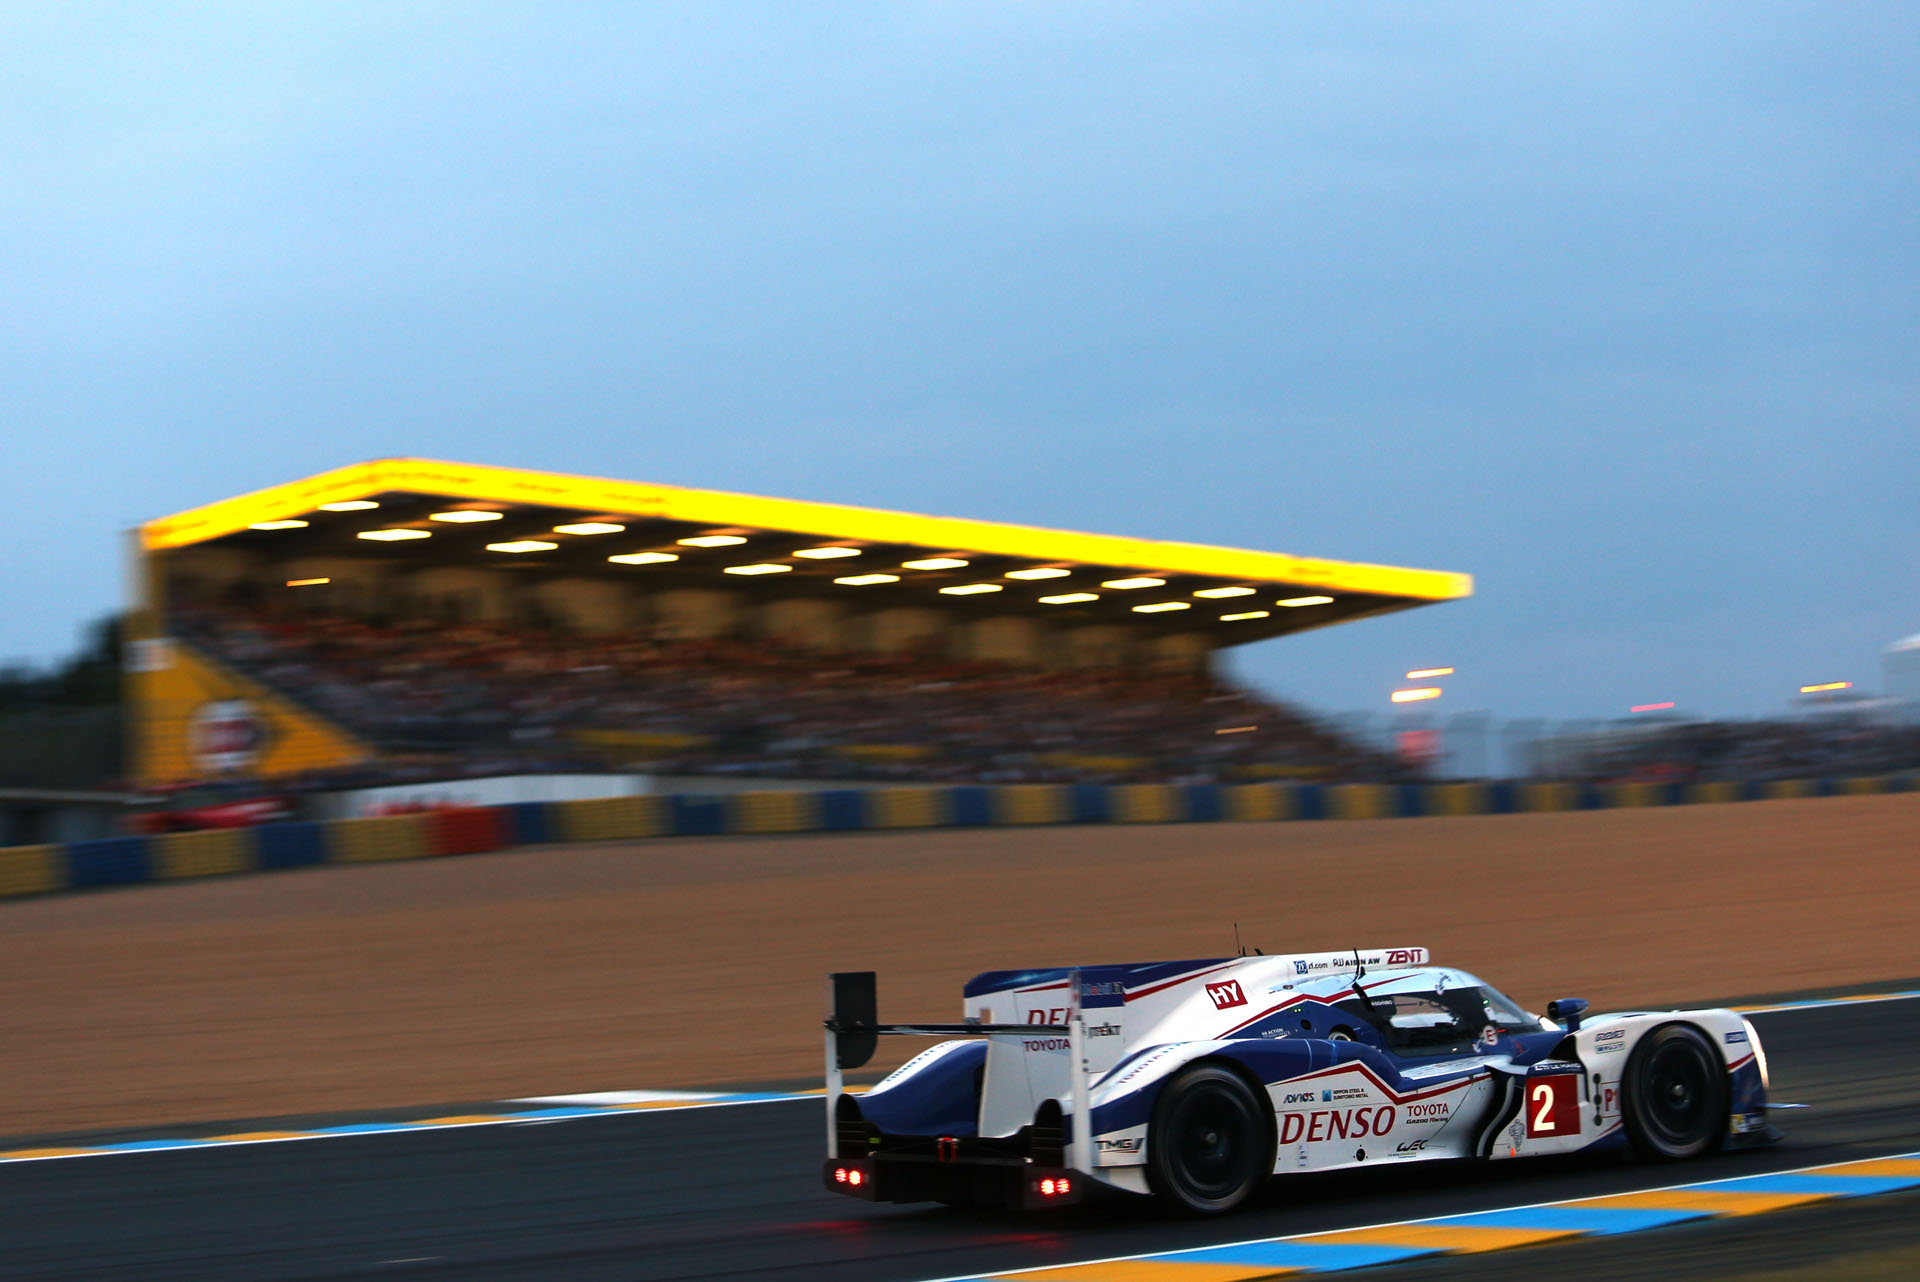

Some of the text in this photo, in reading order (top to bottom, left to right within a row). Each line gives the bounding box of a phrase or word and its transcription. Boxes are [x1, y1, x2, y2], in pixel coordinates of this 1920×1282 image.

[1367, 957, 1380, 965] AW
[1385, 949, 1423, 965] ZENT
[1208, 982, 1240, 1005] HY
[1024, 1039, 1072, 1052] TOYOTA
[1407, 1103, 1449, 1117] TOYOTA
[1532, 1084, 1555, 1132] 2
[1279, 1105, 1396, 1145] DENSO
[1396, 1138, 1430, 1152] WEC
